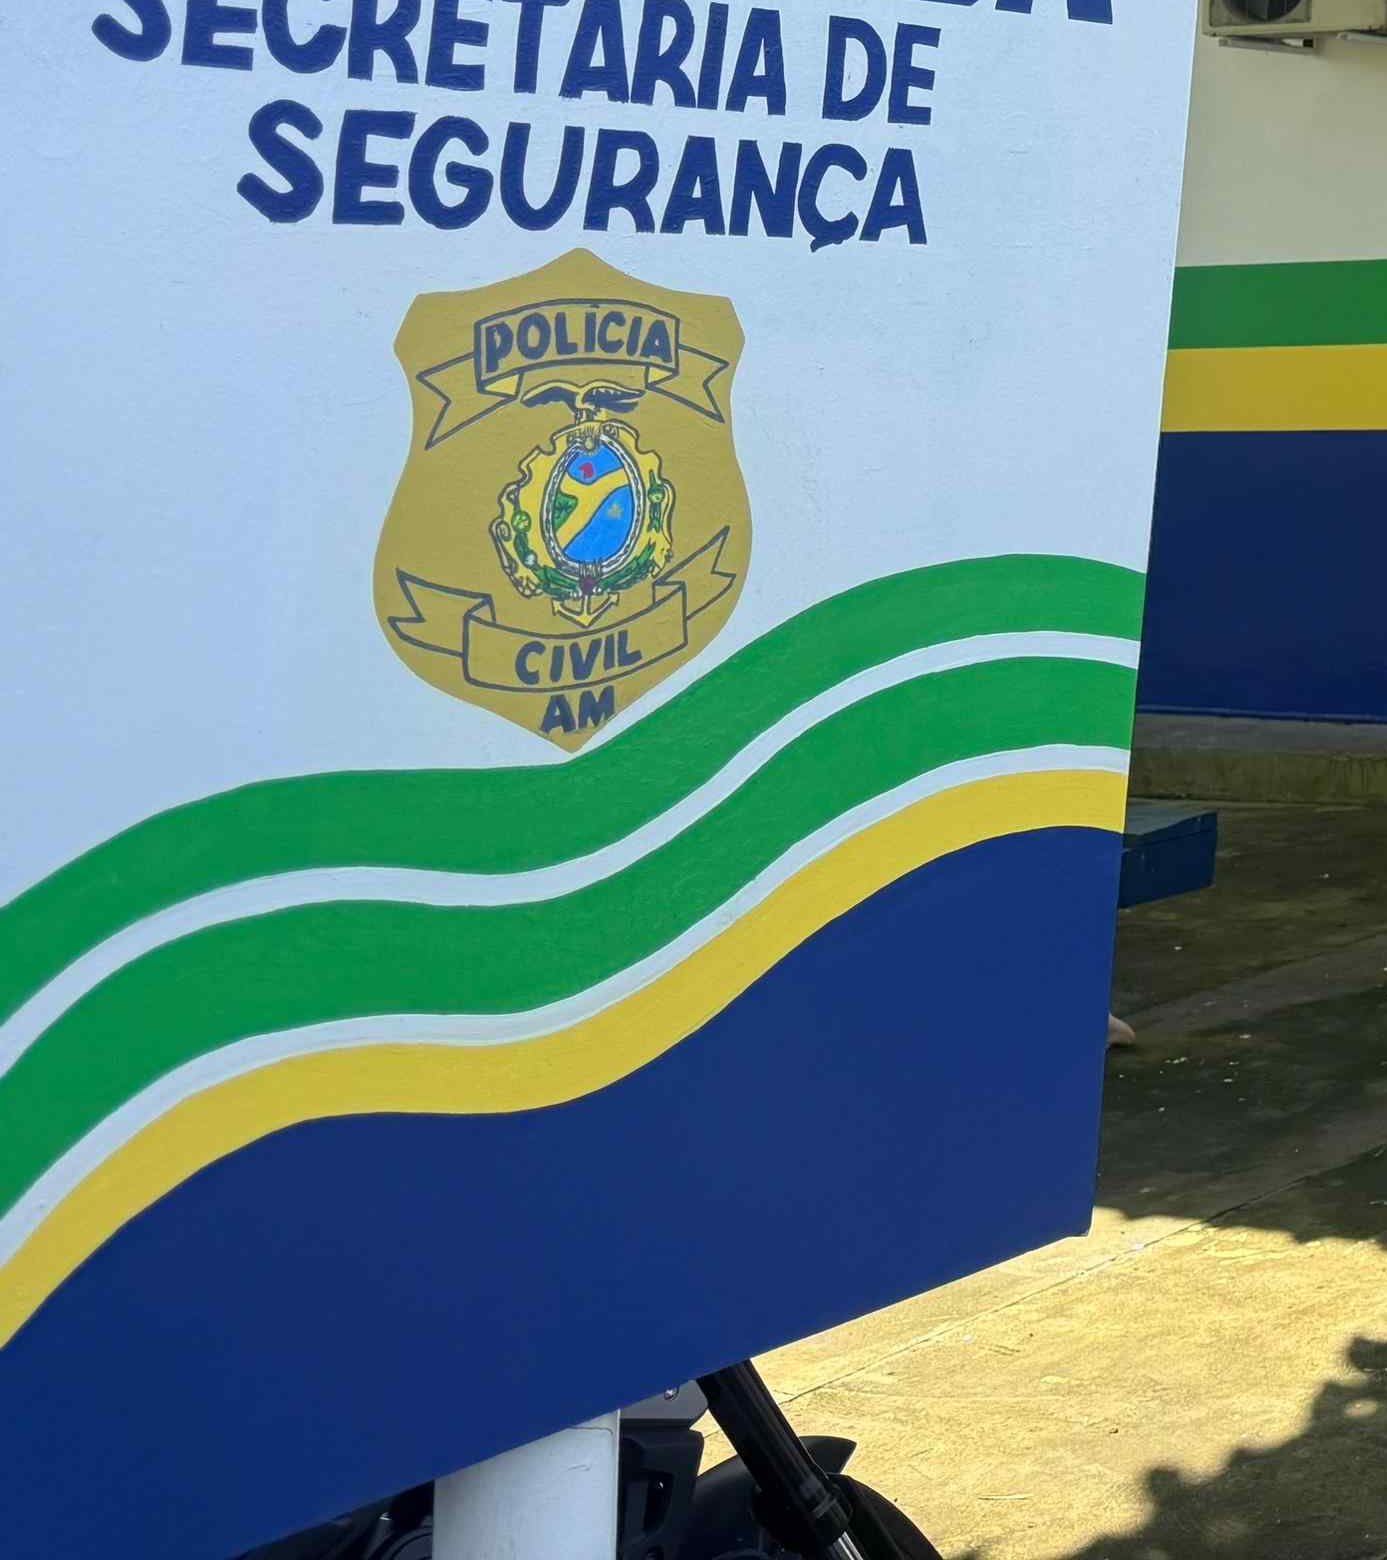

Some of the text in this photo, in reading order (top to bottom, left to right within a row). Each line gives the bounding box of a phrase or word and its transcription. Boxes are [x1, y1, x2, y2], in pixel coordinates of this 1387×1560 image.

[821, 15, 943, 126] DE
[236, 99, 928, 252] SEGURANÇA
[515, 629, 643, 686] CIVIL
[540, 685, 616, 734] AM
